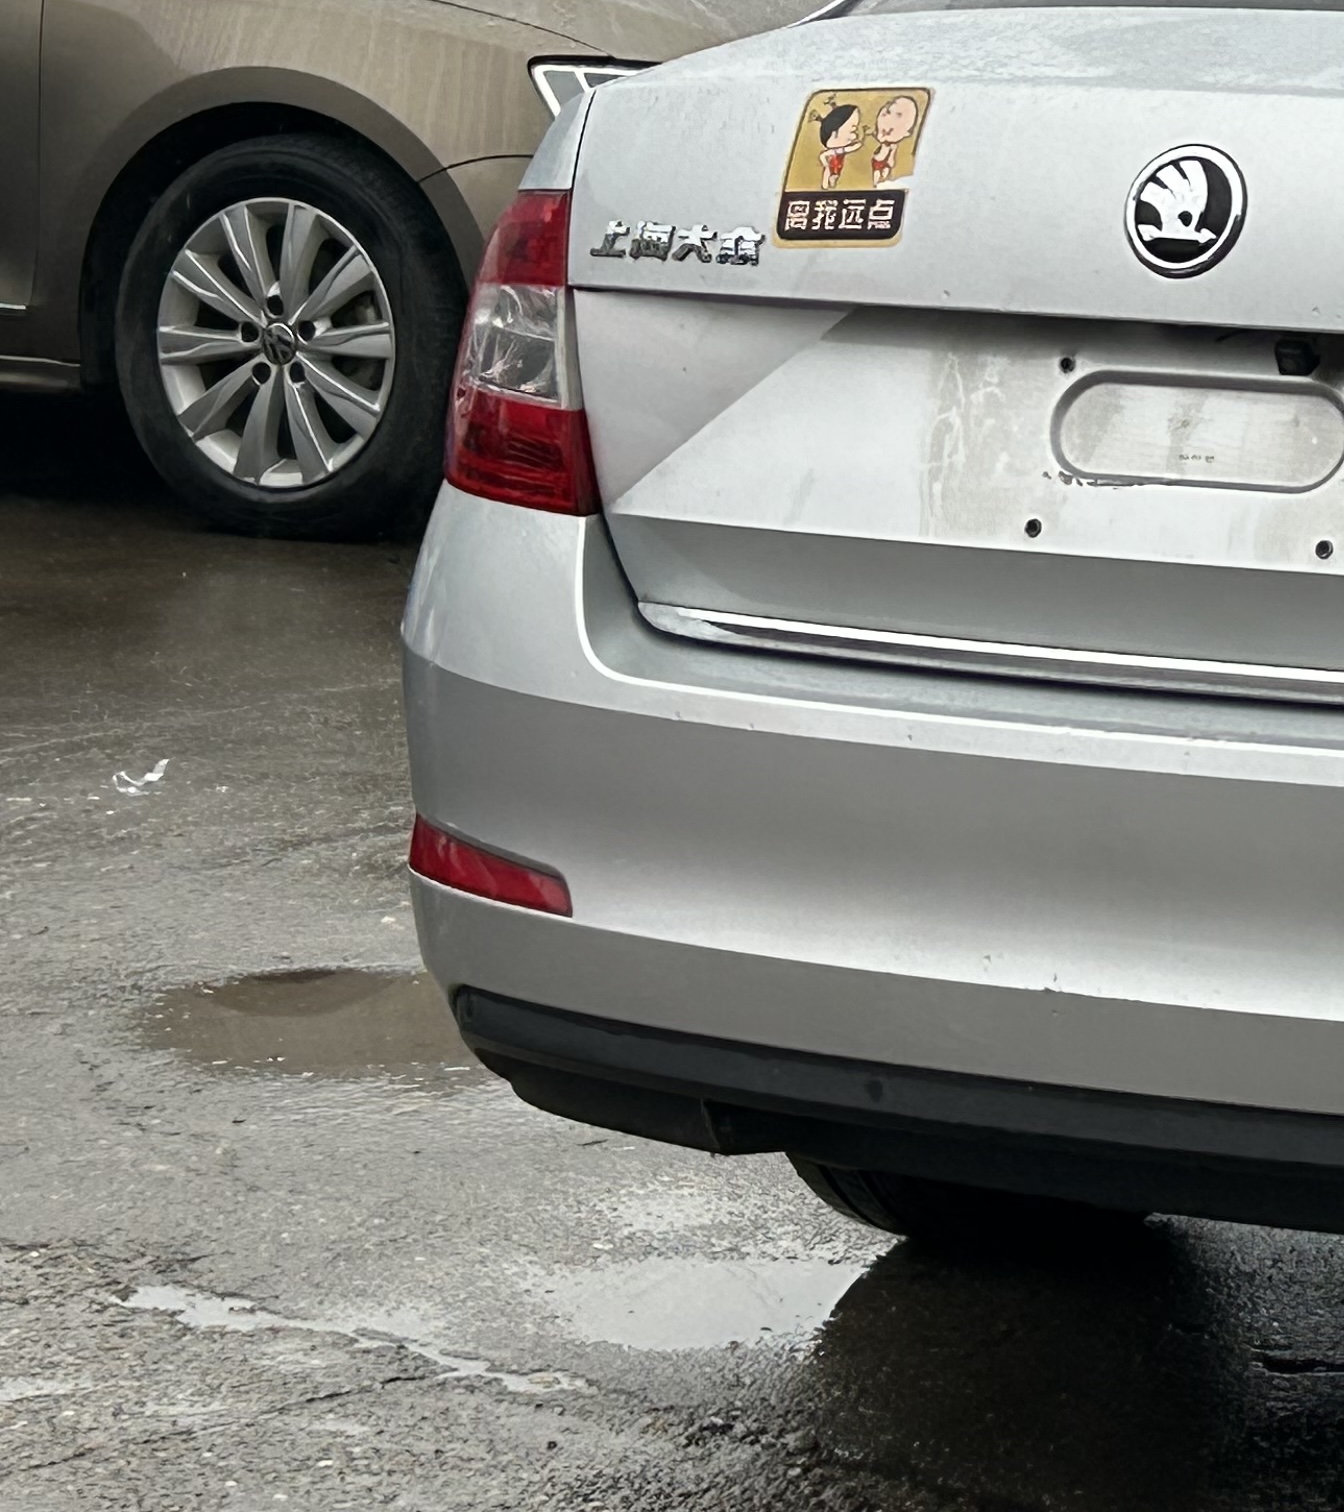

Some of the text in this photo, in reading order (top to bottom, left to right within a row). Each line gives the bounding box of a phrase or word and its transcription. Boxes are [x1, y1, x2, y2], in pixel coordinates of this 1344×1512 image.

[784, 198, 896, 231] 离我远点
[590, 220, 766, 265] 上海大众
